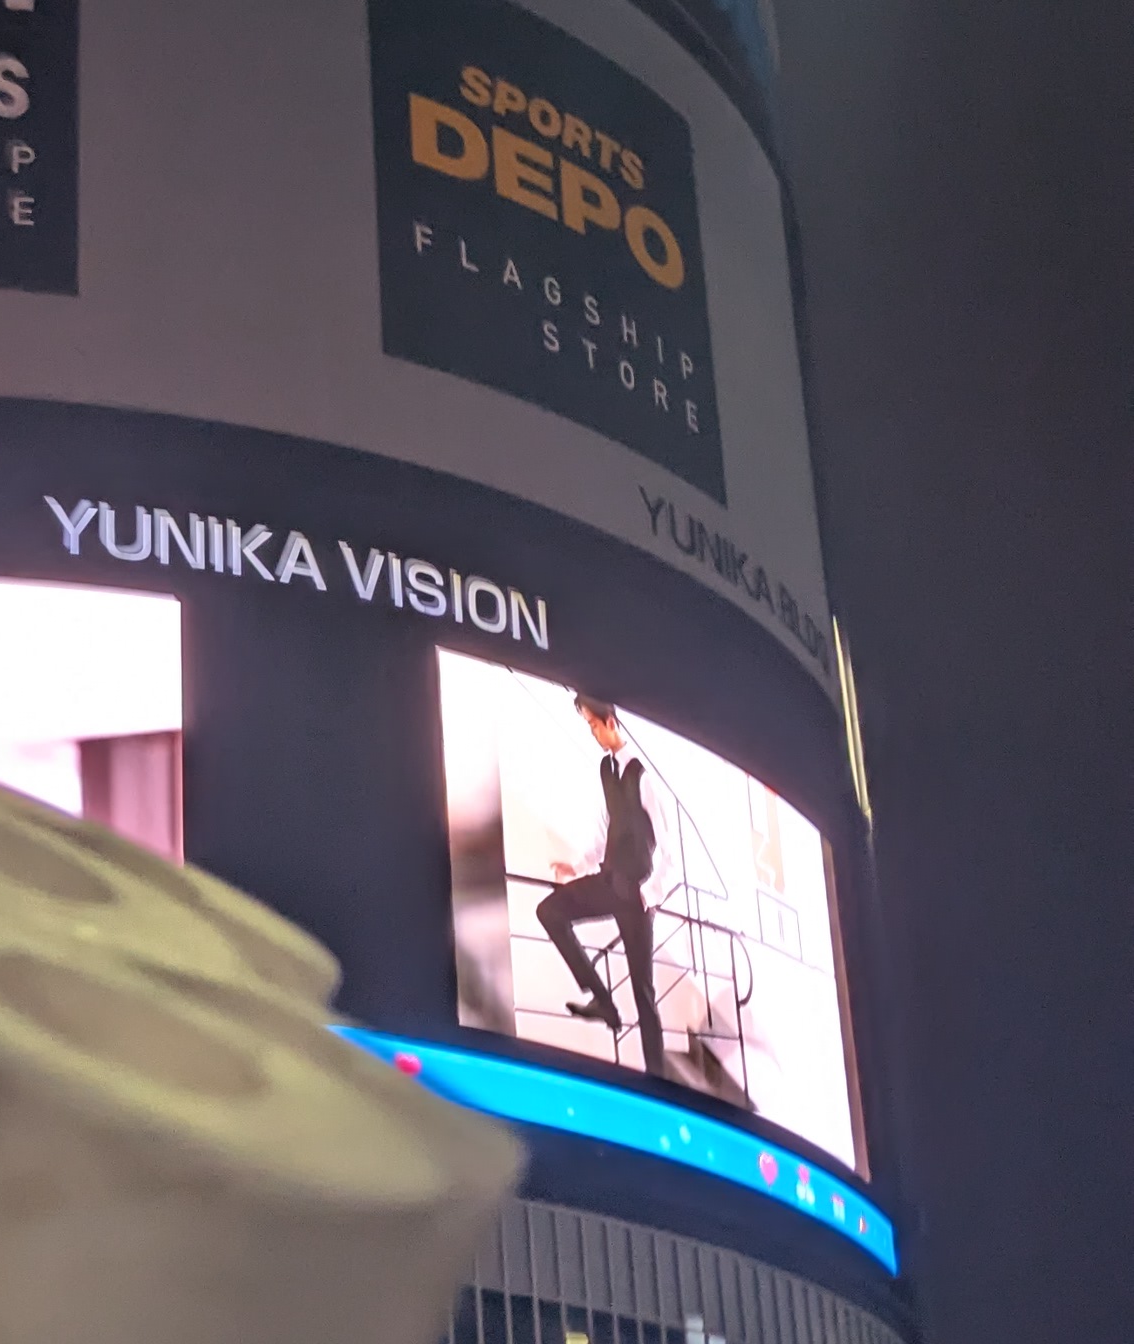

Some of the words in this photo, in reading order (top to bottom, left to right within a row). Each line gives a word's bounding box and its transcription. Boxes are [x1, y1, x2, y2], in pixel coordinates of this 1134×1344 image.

[409, 92, 686, 291] DEPO
[459, 66, 646, 189] SPORTS
[413, 221, 694, 380] FLAGSHIP
[542, 319, 700, 434] STORE
[44, 495, 328, 592] YUNIKA
[338, 539, 550, 651] VISION
[638, 484, 775, 615] YUNIKA
